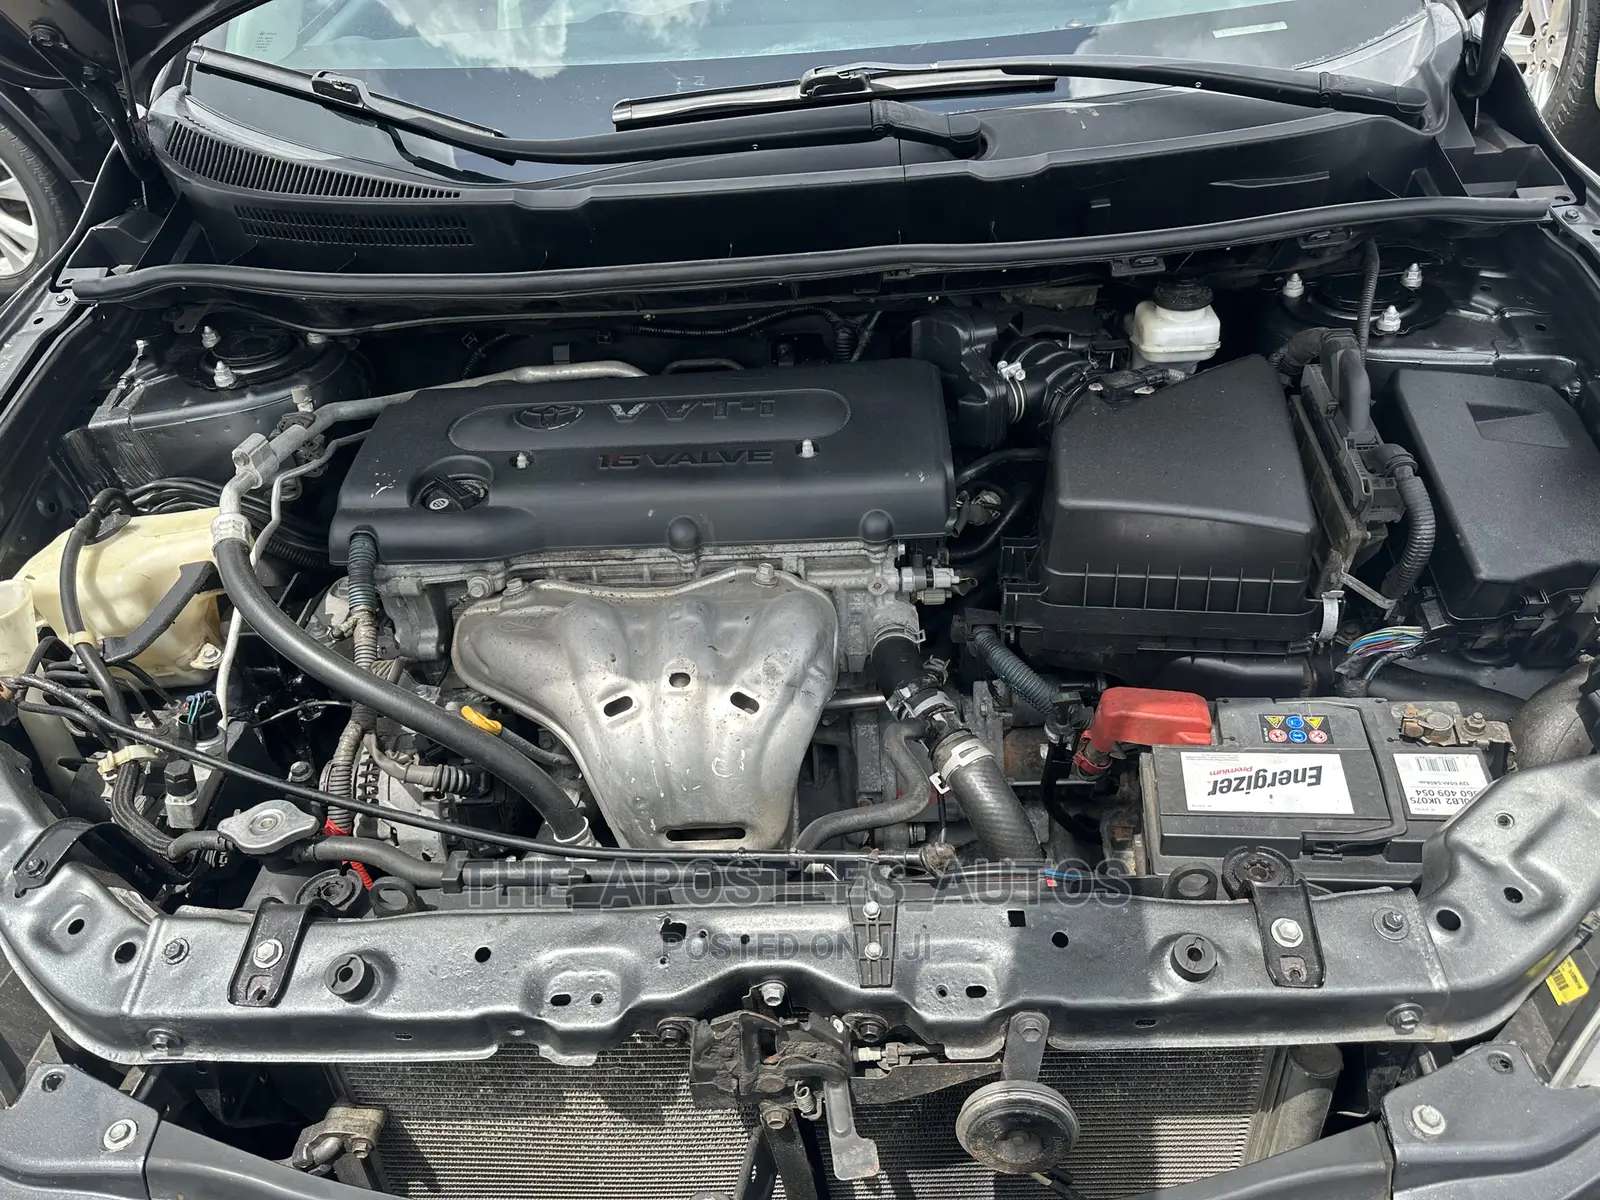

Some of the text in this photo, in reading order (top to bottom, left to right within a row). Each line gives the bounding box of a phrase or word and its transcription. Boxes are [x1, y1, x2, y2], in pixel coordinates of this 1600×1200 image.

[646, 450, 774, 468] VALVE
[1209, 766, 1253, 777] Premium
[1207, 766, 1322, 797] Energizer
[1415, 789, 1435, 797] 054
[1437, 789, 1457, 797] 409
